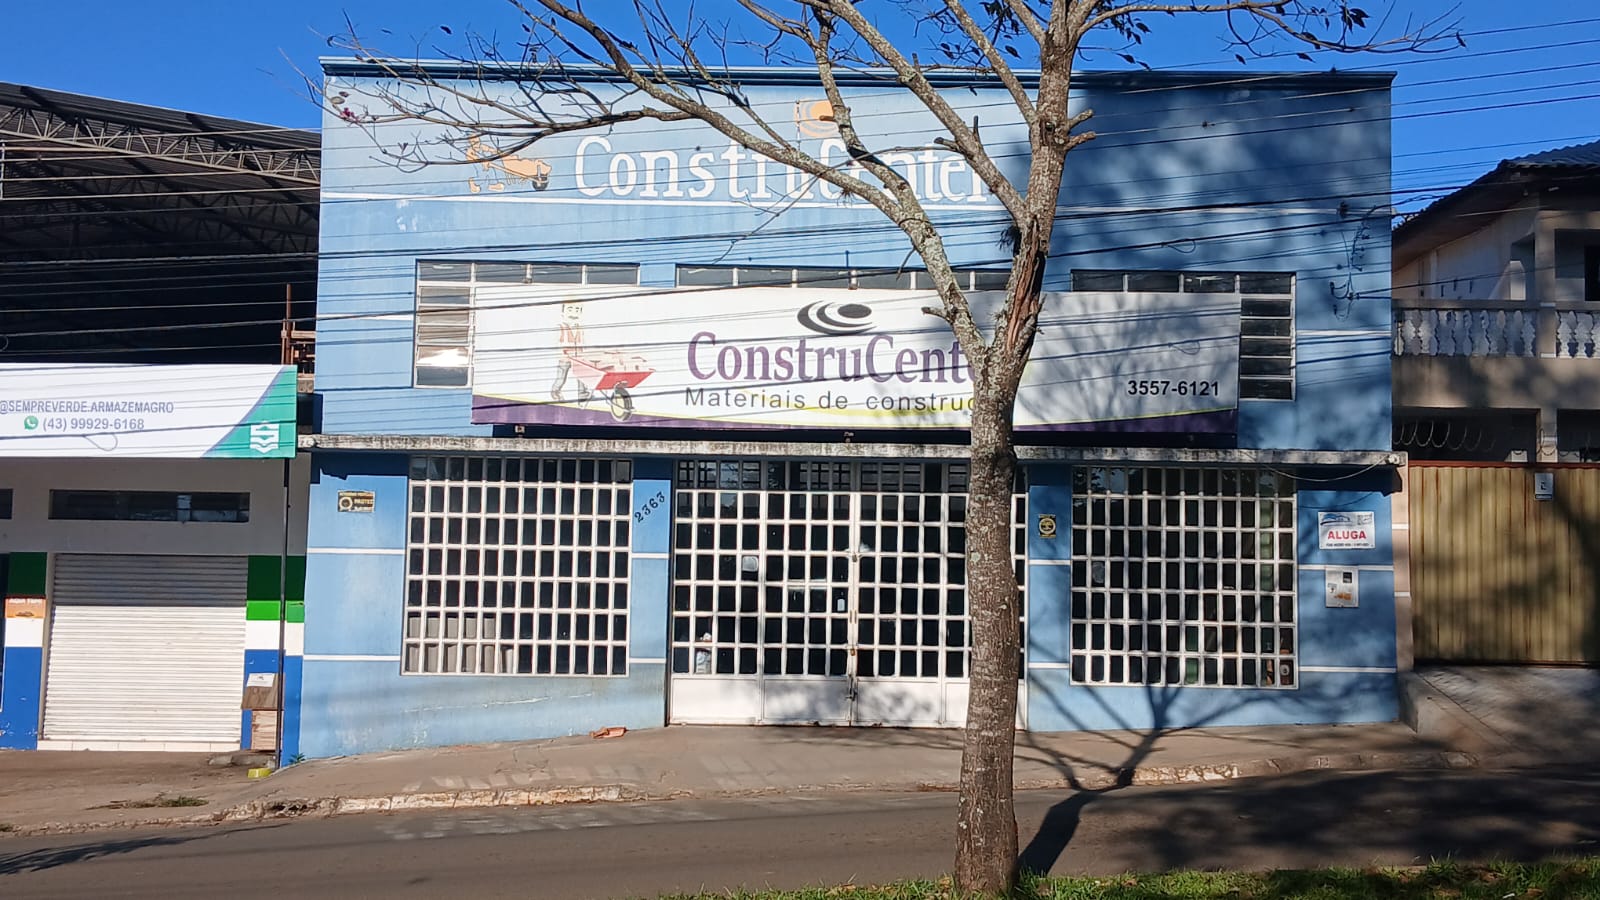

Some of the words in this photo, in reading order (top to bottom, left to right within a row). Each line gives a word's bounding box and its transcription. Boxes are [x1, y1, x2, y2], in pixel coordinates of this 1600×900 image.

[1127, 380, 1219, 396] 3557-6121
[685, 387, 805, 409] Materiais
[818, 390, 848, 410] de
[43, 417, 67, 432] (43)
[71, 418, 144, 430] 99929-6168
[634, 491, 665, 523] 2363
[1327, 530, 1367, 540] ALUGA
